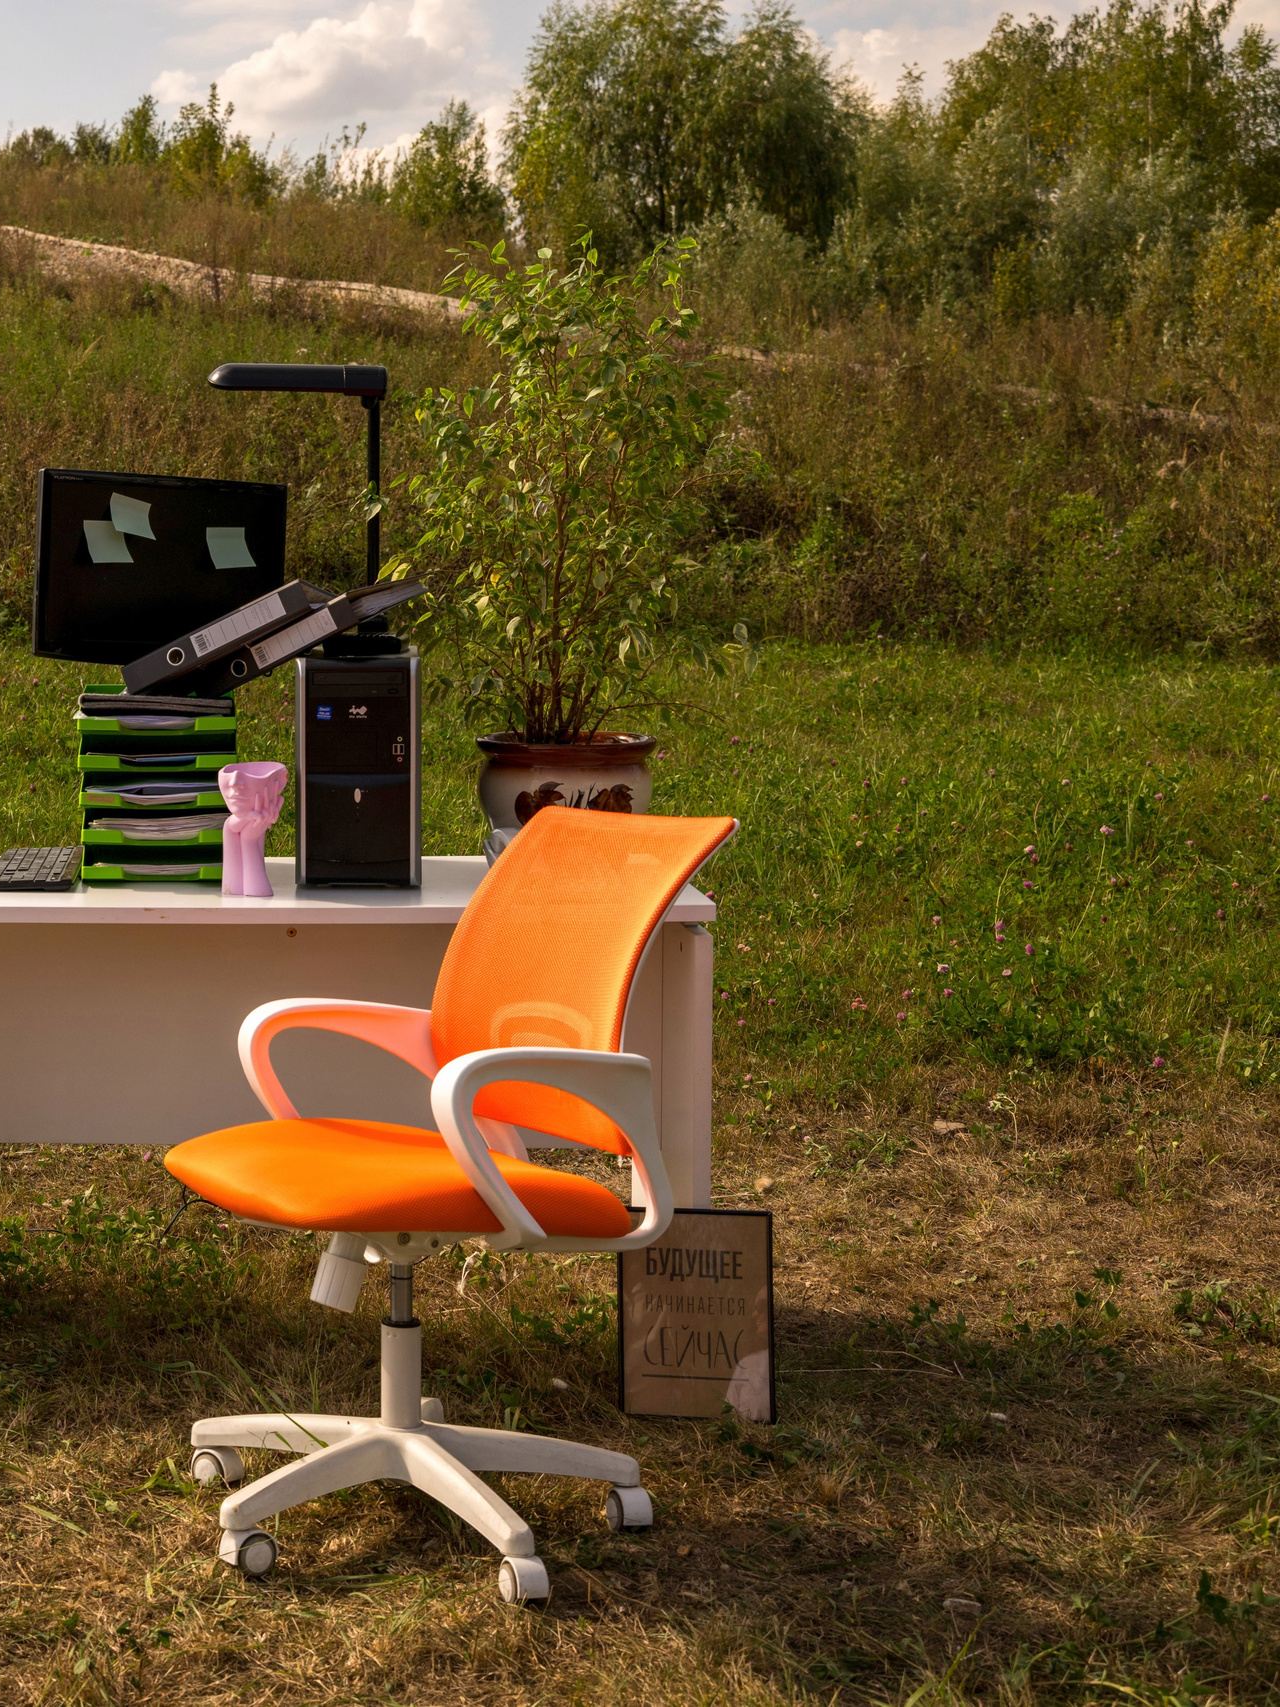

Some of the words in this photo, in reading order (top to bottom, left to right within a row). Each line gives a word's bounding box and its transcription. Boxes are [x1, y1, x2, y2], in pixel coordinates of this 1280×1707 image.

[646, 1247, 743, 1283] БУДУЩЕЕ
[645, 1294, 746, 1316] НАЧИНАЕТСЯ
[643, 1324, 748, 1370] СЕЙЧАС
